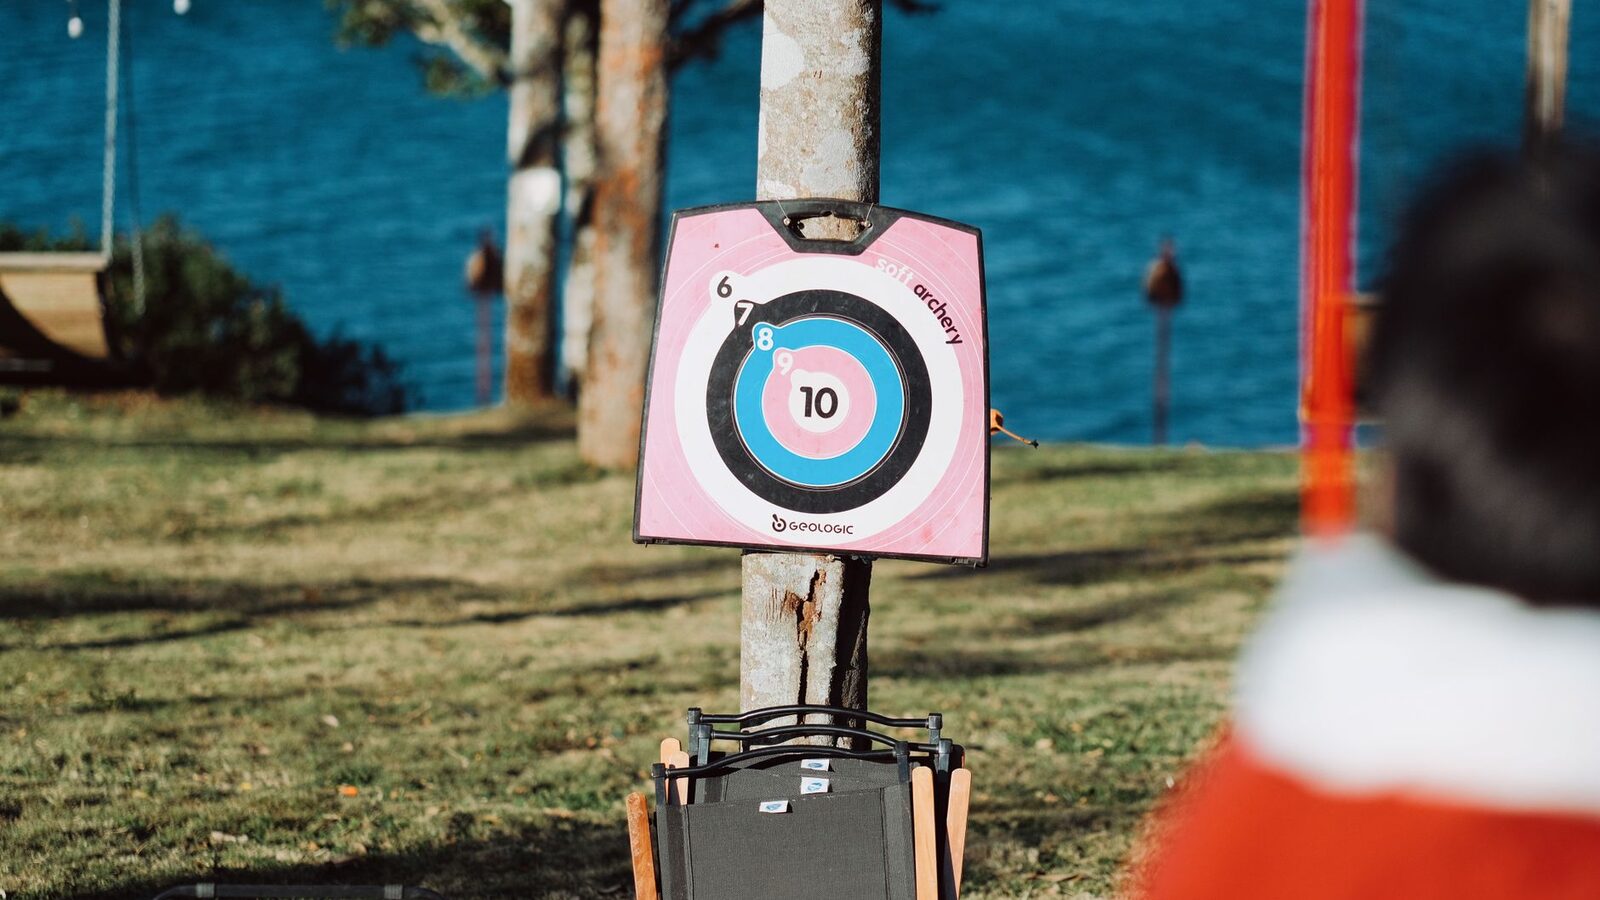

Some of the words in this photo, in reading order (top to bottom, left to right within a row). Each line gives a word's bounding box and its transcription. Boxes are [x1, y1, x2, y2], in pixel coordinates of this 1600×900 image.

[717, 275, 732, 298] 6
[876, 258, 914, 285] soft
[913, 284, 963, 344] archery
[737, 302, 754, 326] 7
[757, 327, 774, 351] 8
[777, 351, 793, 376] 9
[799, 386, 838, 419] 10
